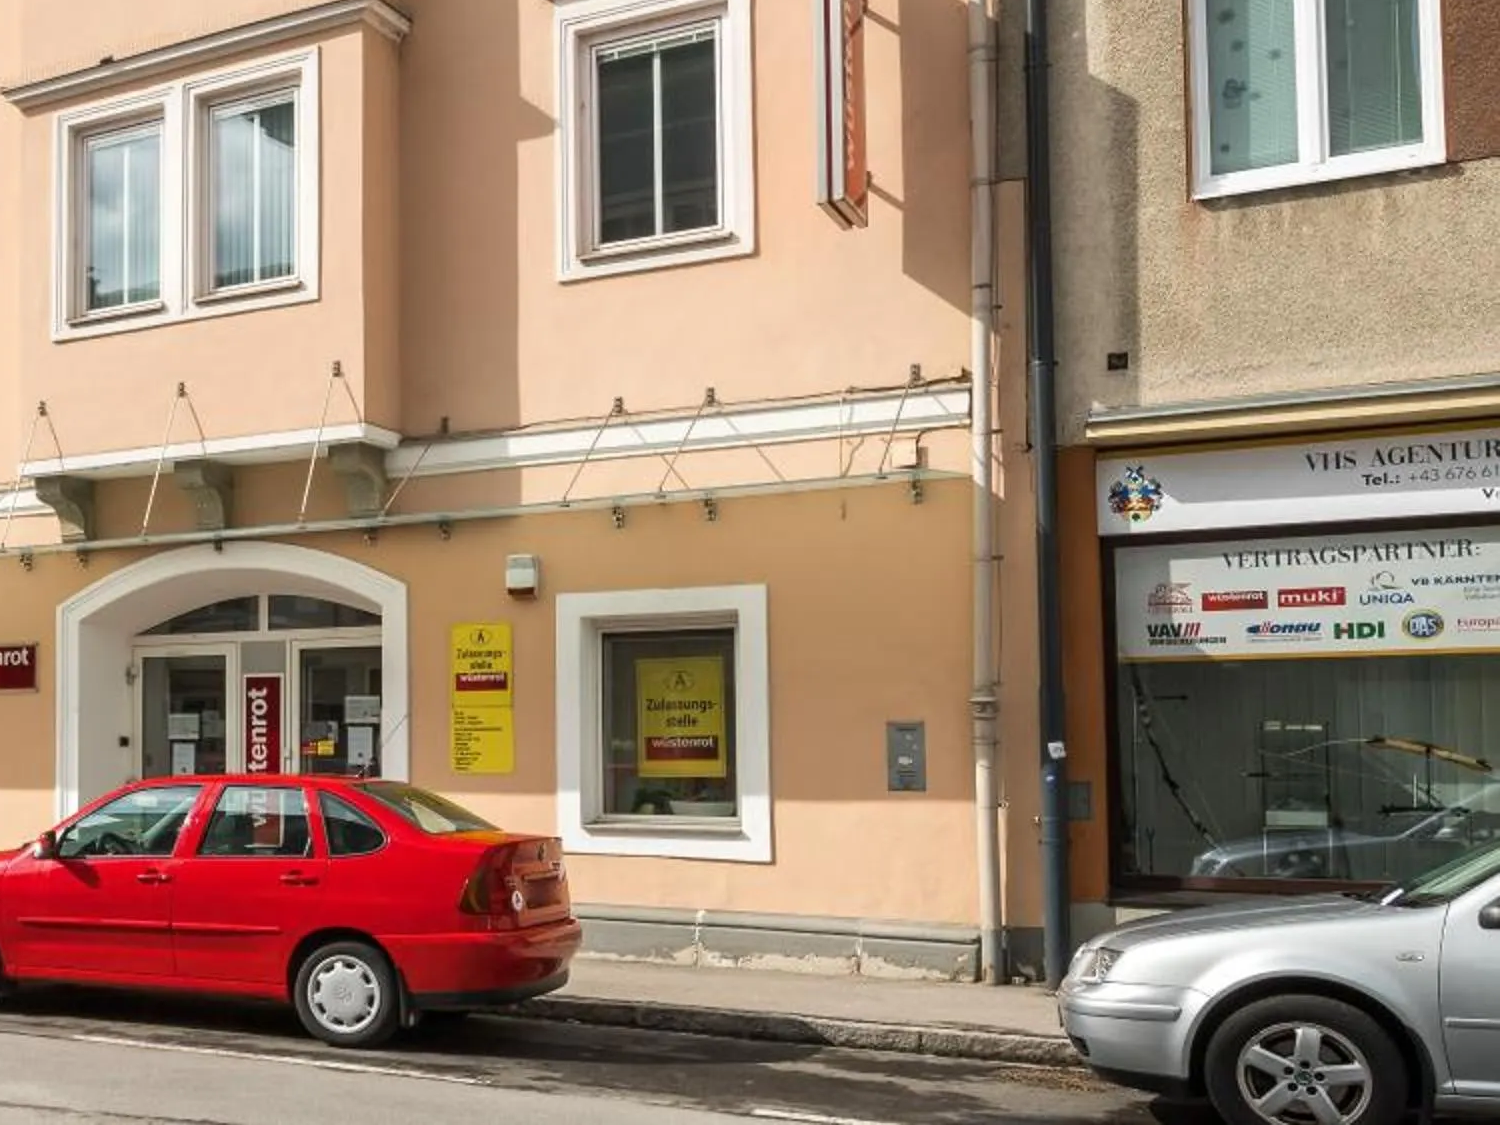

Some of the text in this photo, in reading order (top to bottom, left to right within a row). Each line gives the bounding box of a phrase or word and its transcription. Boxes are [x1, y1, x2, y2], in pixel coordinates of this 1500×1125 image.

[1304, 439, 1500, 472] VHS AGENTUR
[1222, 539, 1480, 569] VERTRAGSPARTNER:
[1359, 592, 1415, 606] UNIQA
[1333, 621, 1386, 640] HDI
